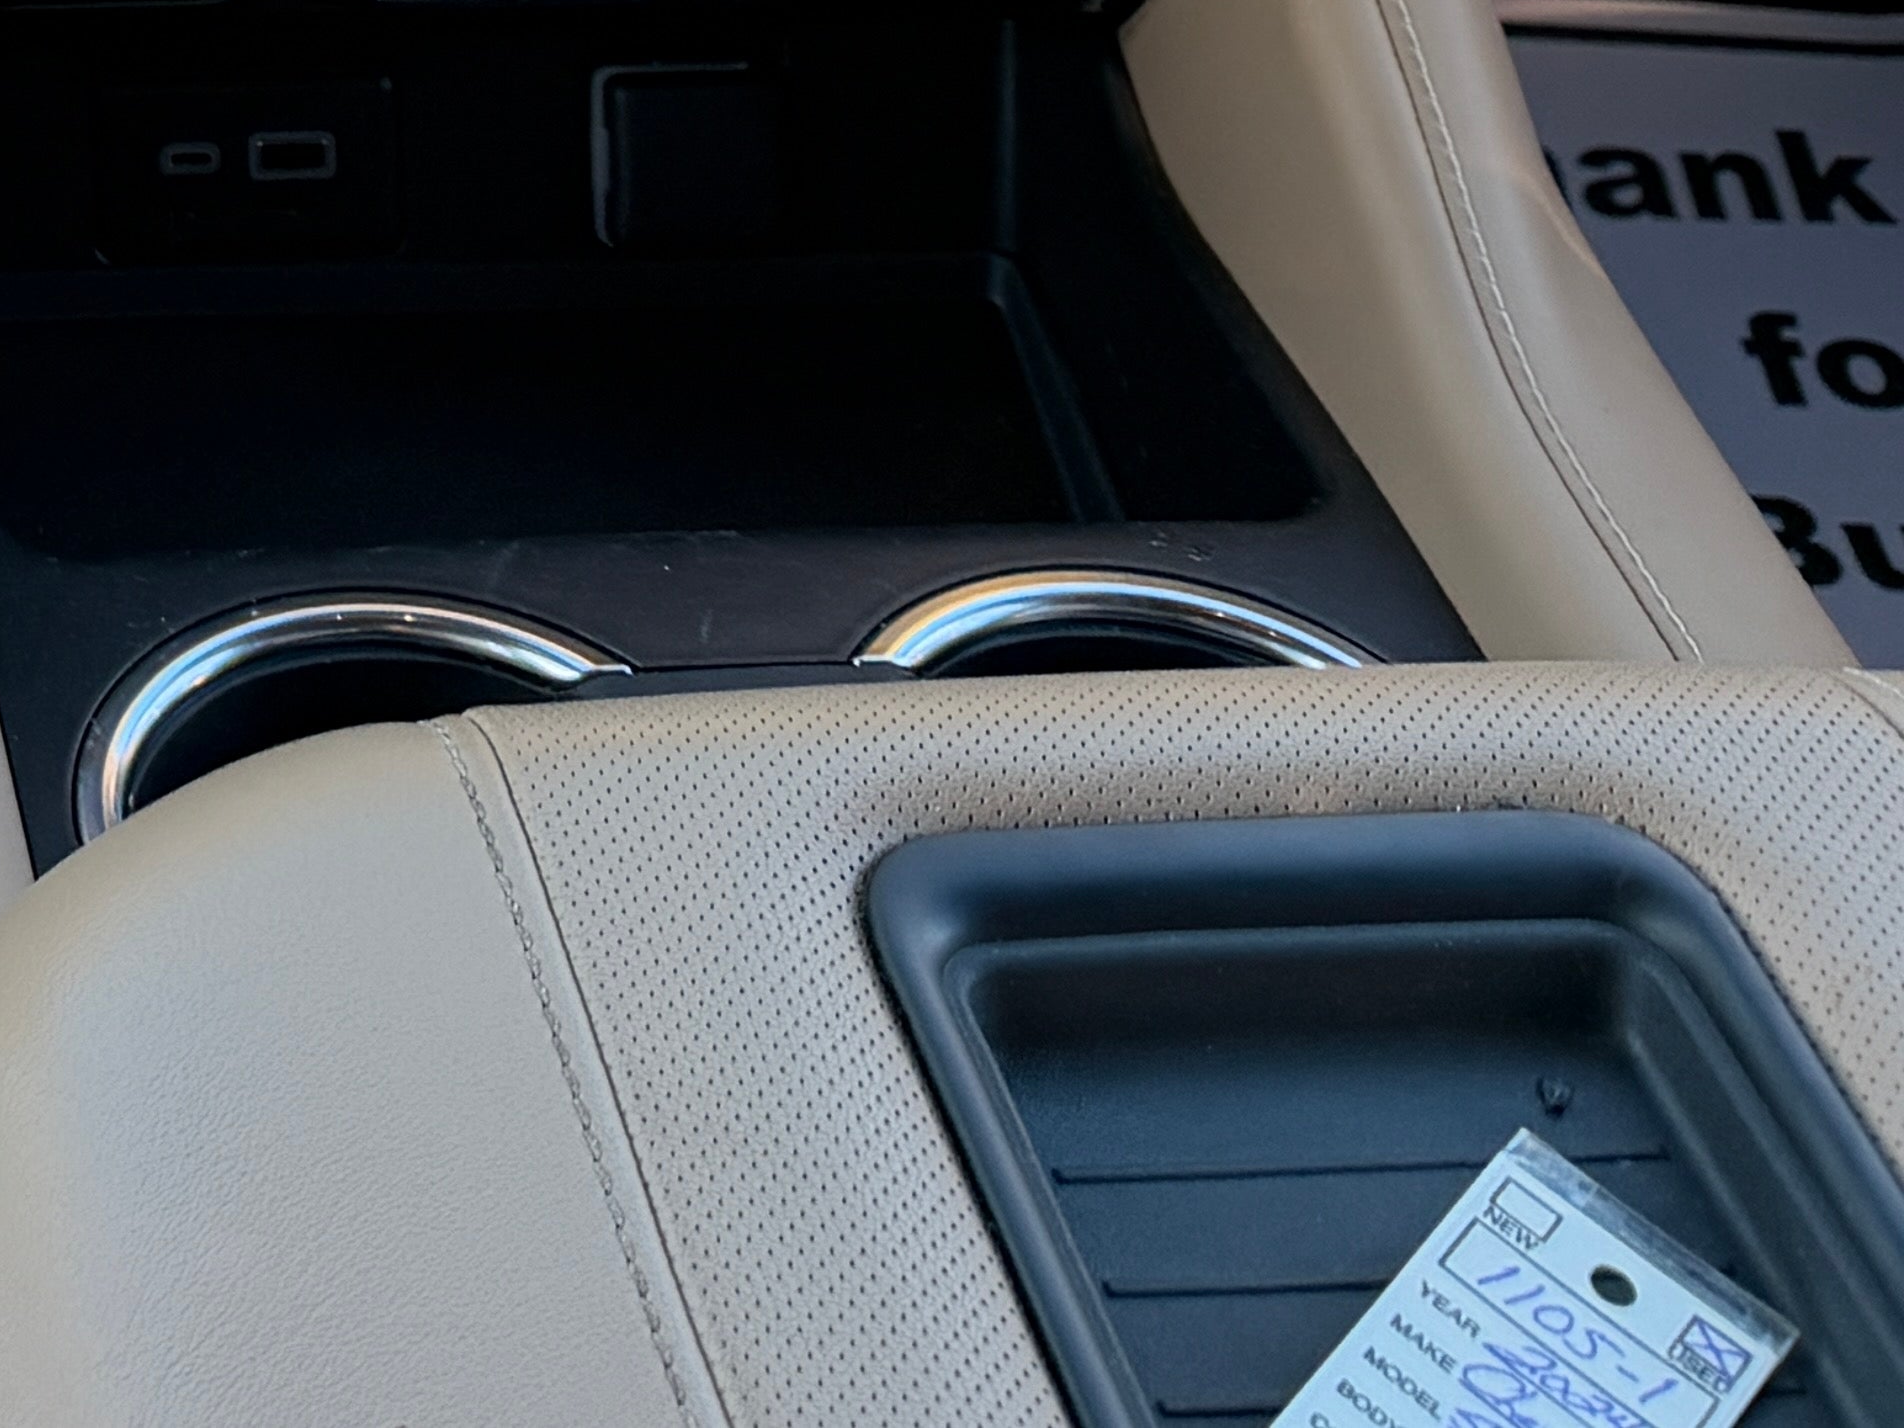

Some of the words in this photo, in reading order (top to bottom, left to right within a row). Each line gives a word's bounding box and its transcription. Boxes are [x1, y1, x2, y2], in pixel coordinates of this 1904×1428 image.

[1542, 128, 1898, 226] ank
[1482, 1205, 1540, 1252] NEW
[1419, 1279, 1481, 1339] YEAR
[1389, 1312, 1457, 1375] MAKE
[1362, 1345, 1442, 1422] MODEL
